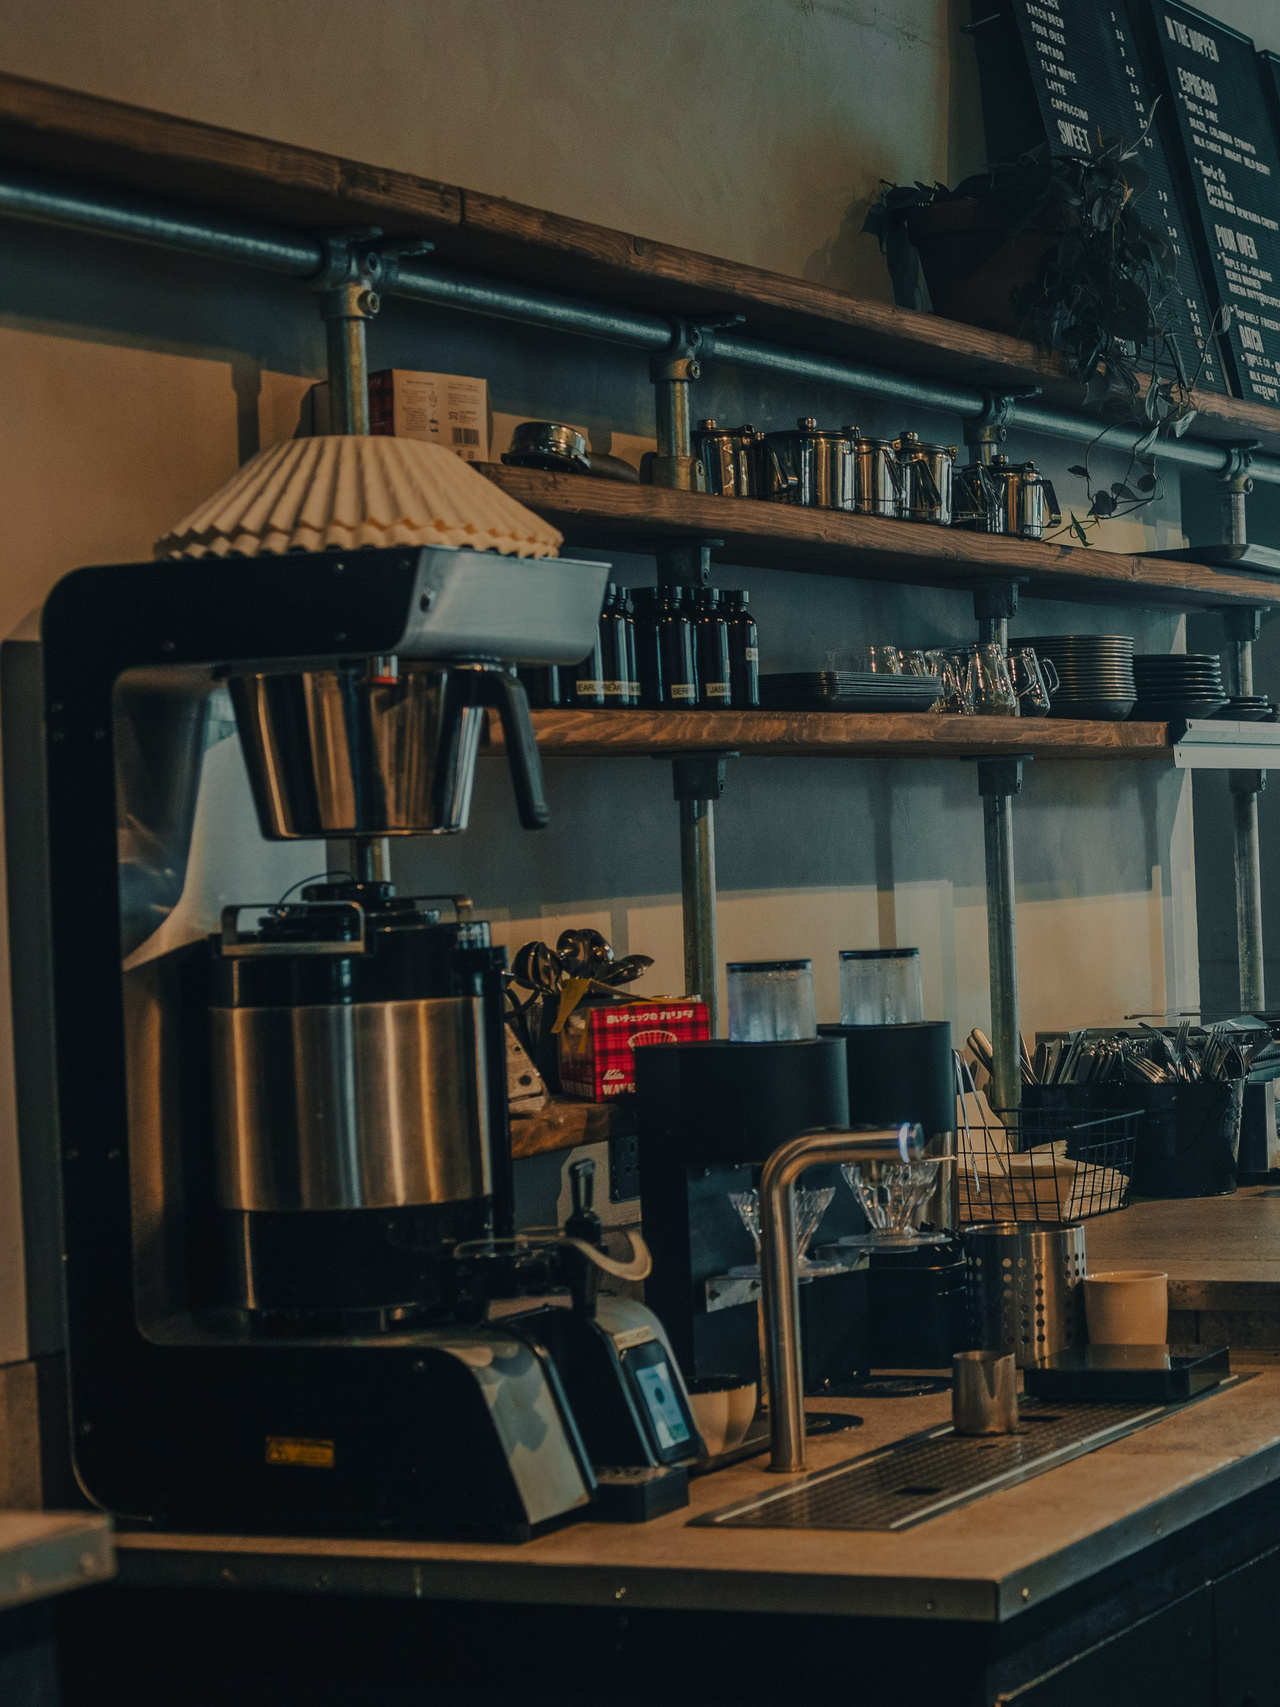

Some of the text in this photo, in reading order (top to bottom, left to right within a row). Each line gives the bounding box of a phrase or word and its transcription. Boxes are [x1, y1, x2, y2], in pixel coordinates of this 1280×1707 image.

[1026, 3, 1047, 21] BATCH
[1040, 0, 1059, 10] LACK
[1031, 21, 1048, 38] POUR
[1049, 29, 1066, 45] OVER
[1172, 20, 1191, 48] THE
[1188, 28, 1219, 62] HOPPER
[1036, 41, 1064, 61] CORTADO
[1041, 59, 1057, 75] FLAT
[1057, 67, 1077, 83] WHITE
[1046, 78, 1067, 96] LATTE
[1177, 67, 1218, 106] ESPRESSO
[1051, 98, 1089, 121] CAPPUCCINO
[1057, 119, 1091, 154] SWEET
[1214, 224, 1258, 260] POUR OVER
[1239, 324, 1264, 353] BATCH
